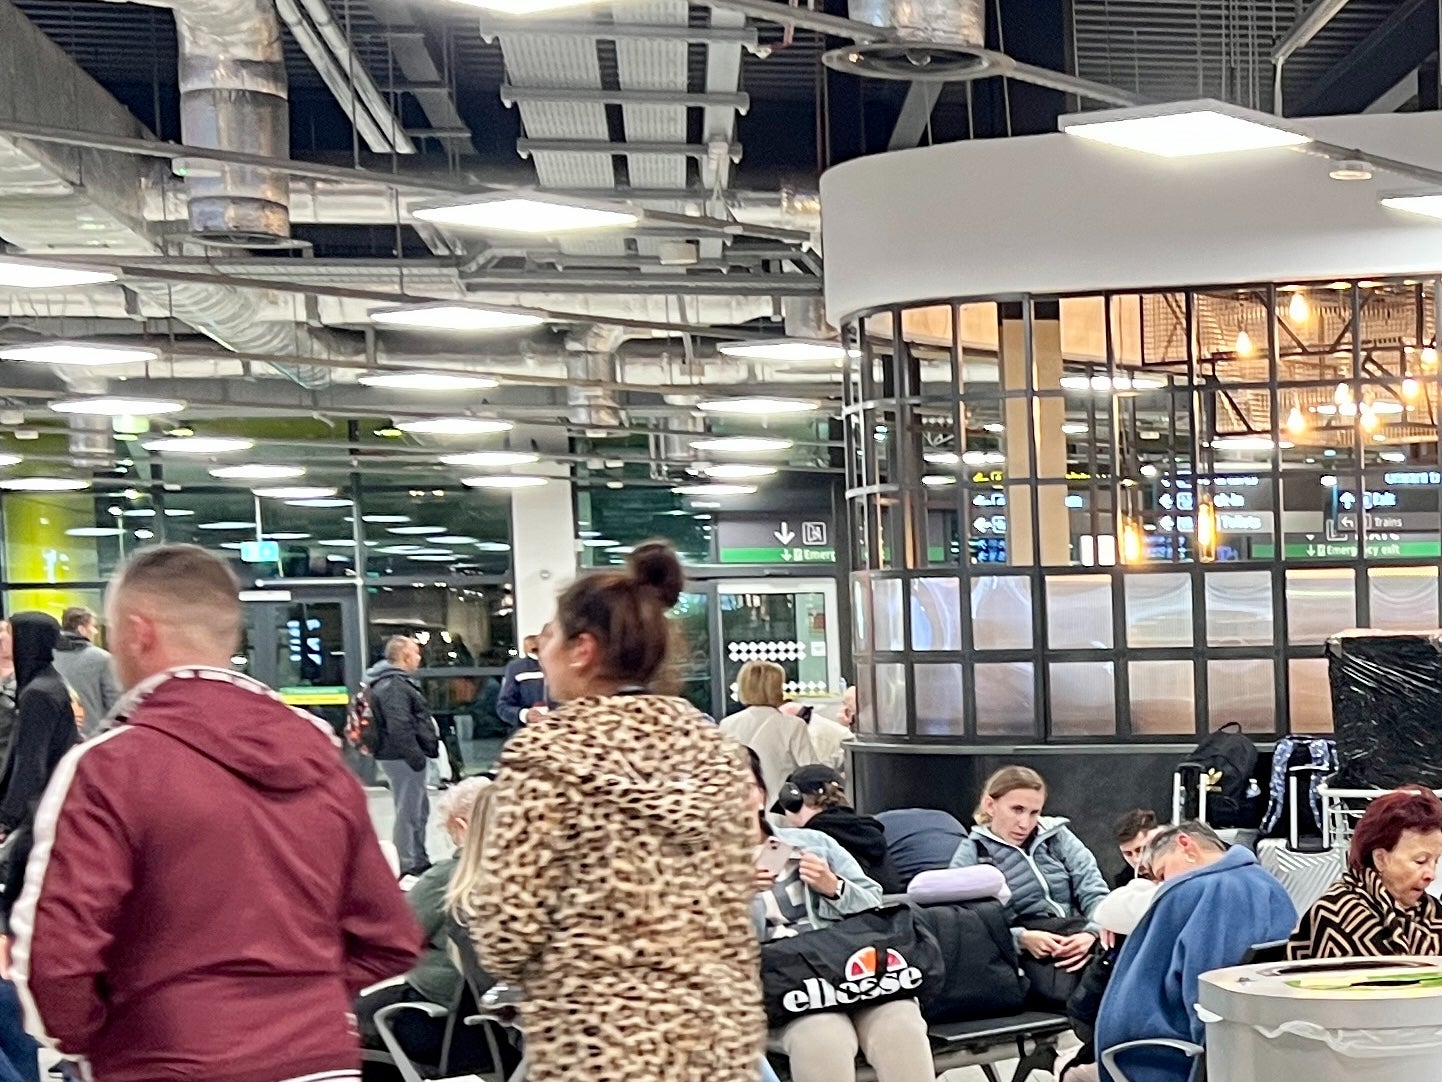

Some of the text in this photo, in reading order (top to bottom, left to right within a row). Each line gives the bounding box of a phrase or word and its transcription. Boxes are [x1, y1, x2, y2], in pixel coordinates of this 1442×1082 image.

[1374, 517, 1403, 527] Trains
[1327, 543, 1400, 557] Emergcy exit
